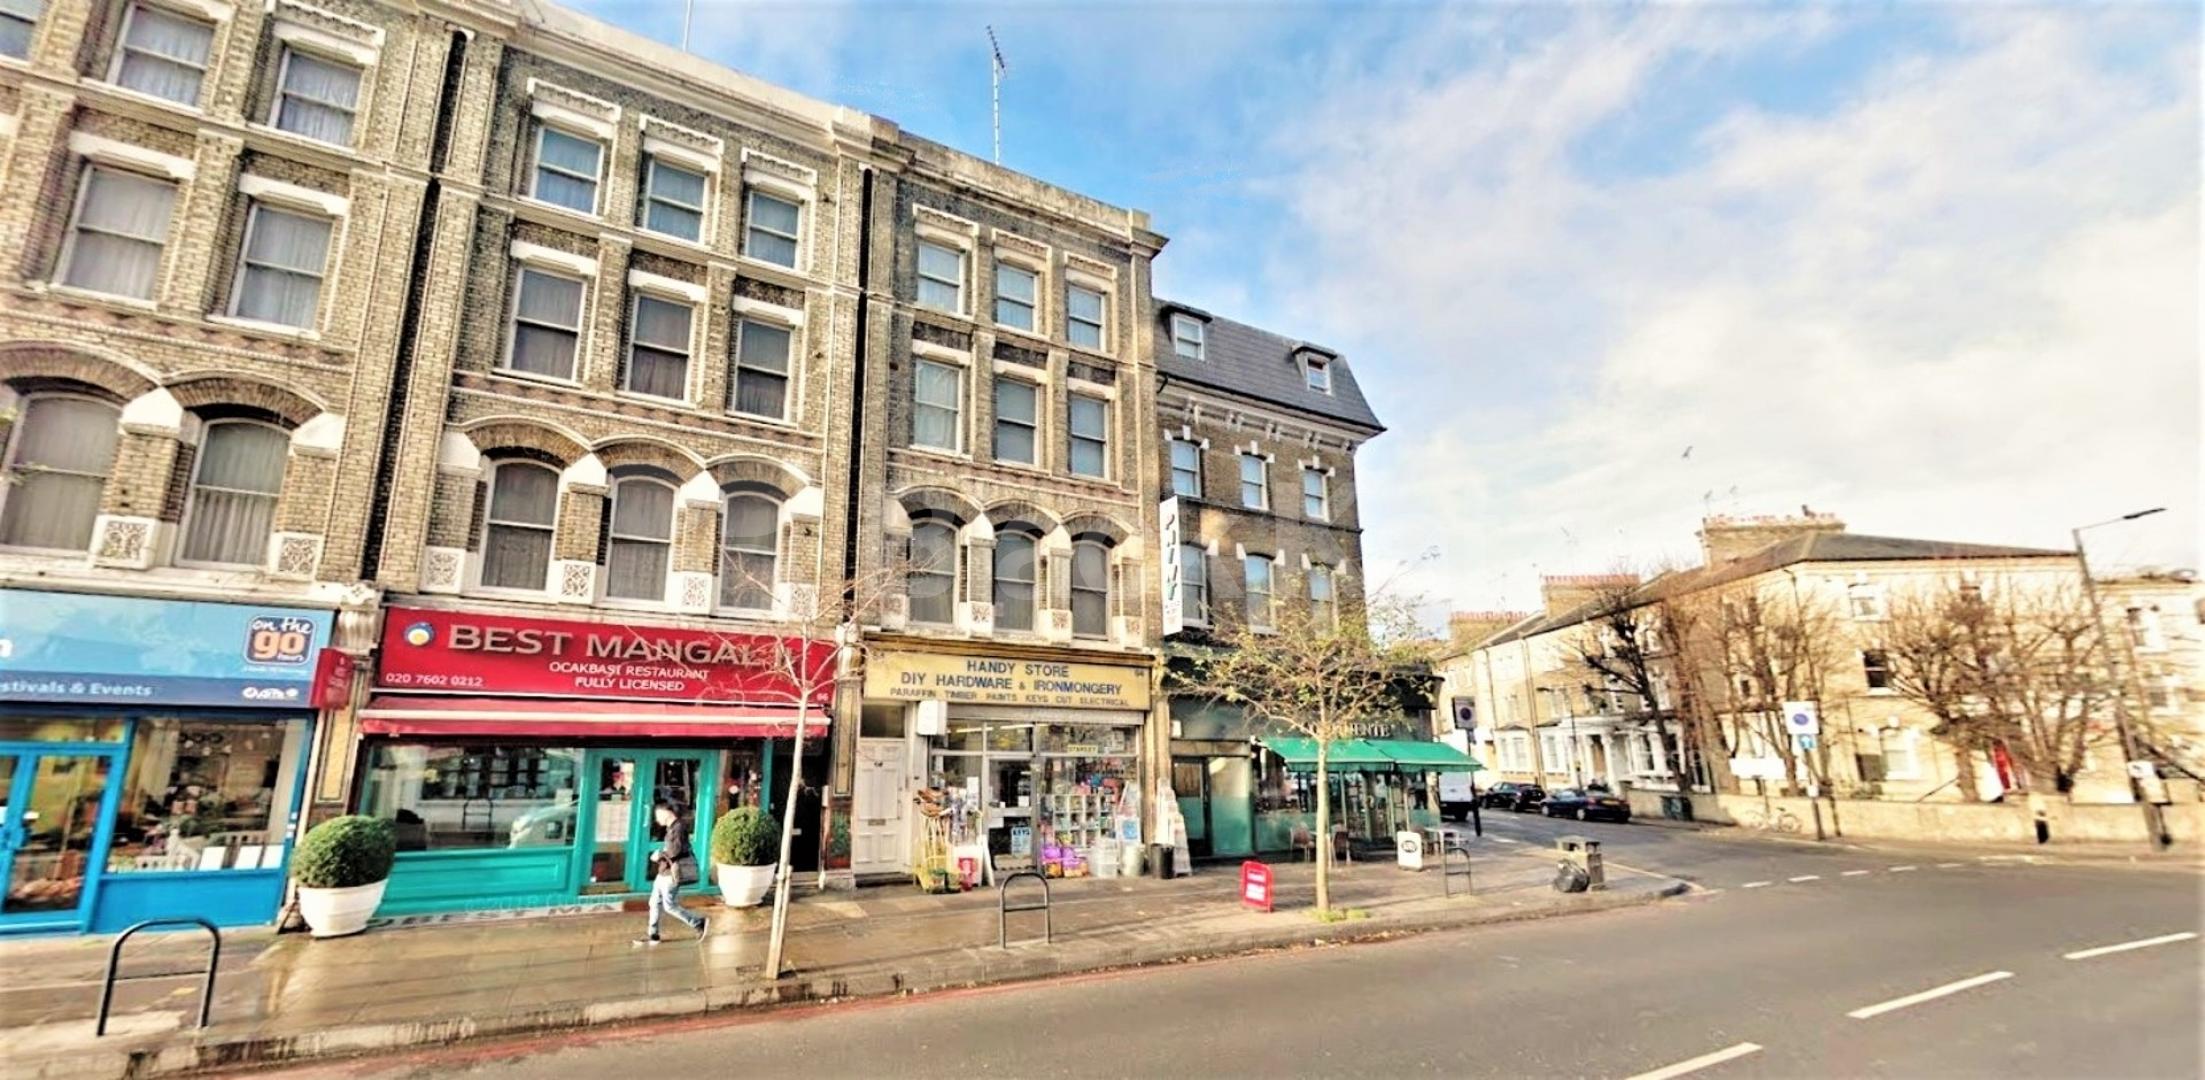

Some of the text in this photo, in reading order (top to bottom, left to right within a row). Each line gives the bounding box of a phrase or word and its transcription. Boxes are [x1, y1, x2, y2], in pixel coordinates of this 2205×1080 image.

[280, 617, 312, 634] the
[254, 631, 305, 660] go
[448, 625, 573, 656] BEST
[585, 633, 763, 668] MANGAL
[625, 665, 709, 681] RESTAURANT
[967, 660, 1069, 677] HANDY STORE
[386, 673, 483, 687] 020 7602 0212
[575, 676, 685, 692] FULLY LICENSED
[901, 672, 927, 685] DIY
[936, 674, 1013, 690] HARDWARE
[1033, 679, 1122, 695] IRONMONGERY
[69, 682, 87, 694] &
[90, 683, 152, 696] Events
[890, 687, 936, 698] PARAFFIN
[1025, 694, 1049, 704] KEYS
[1079, 696, 1129, 707] ELECTRICAL
